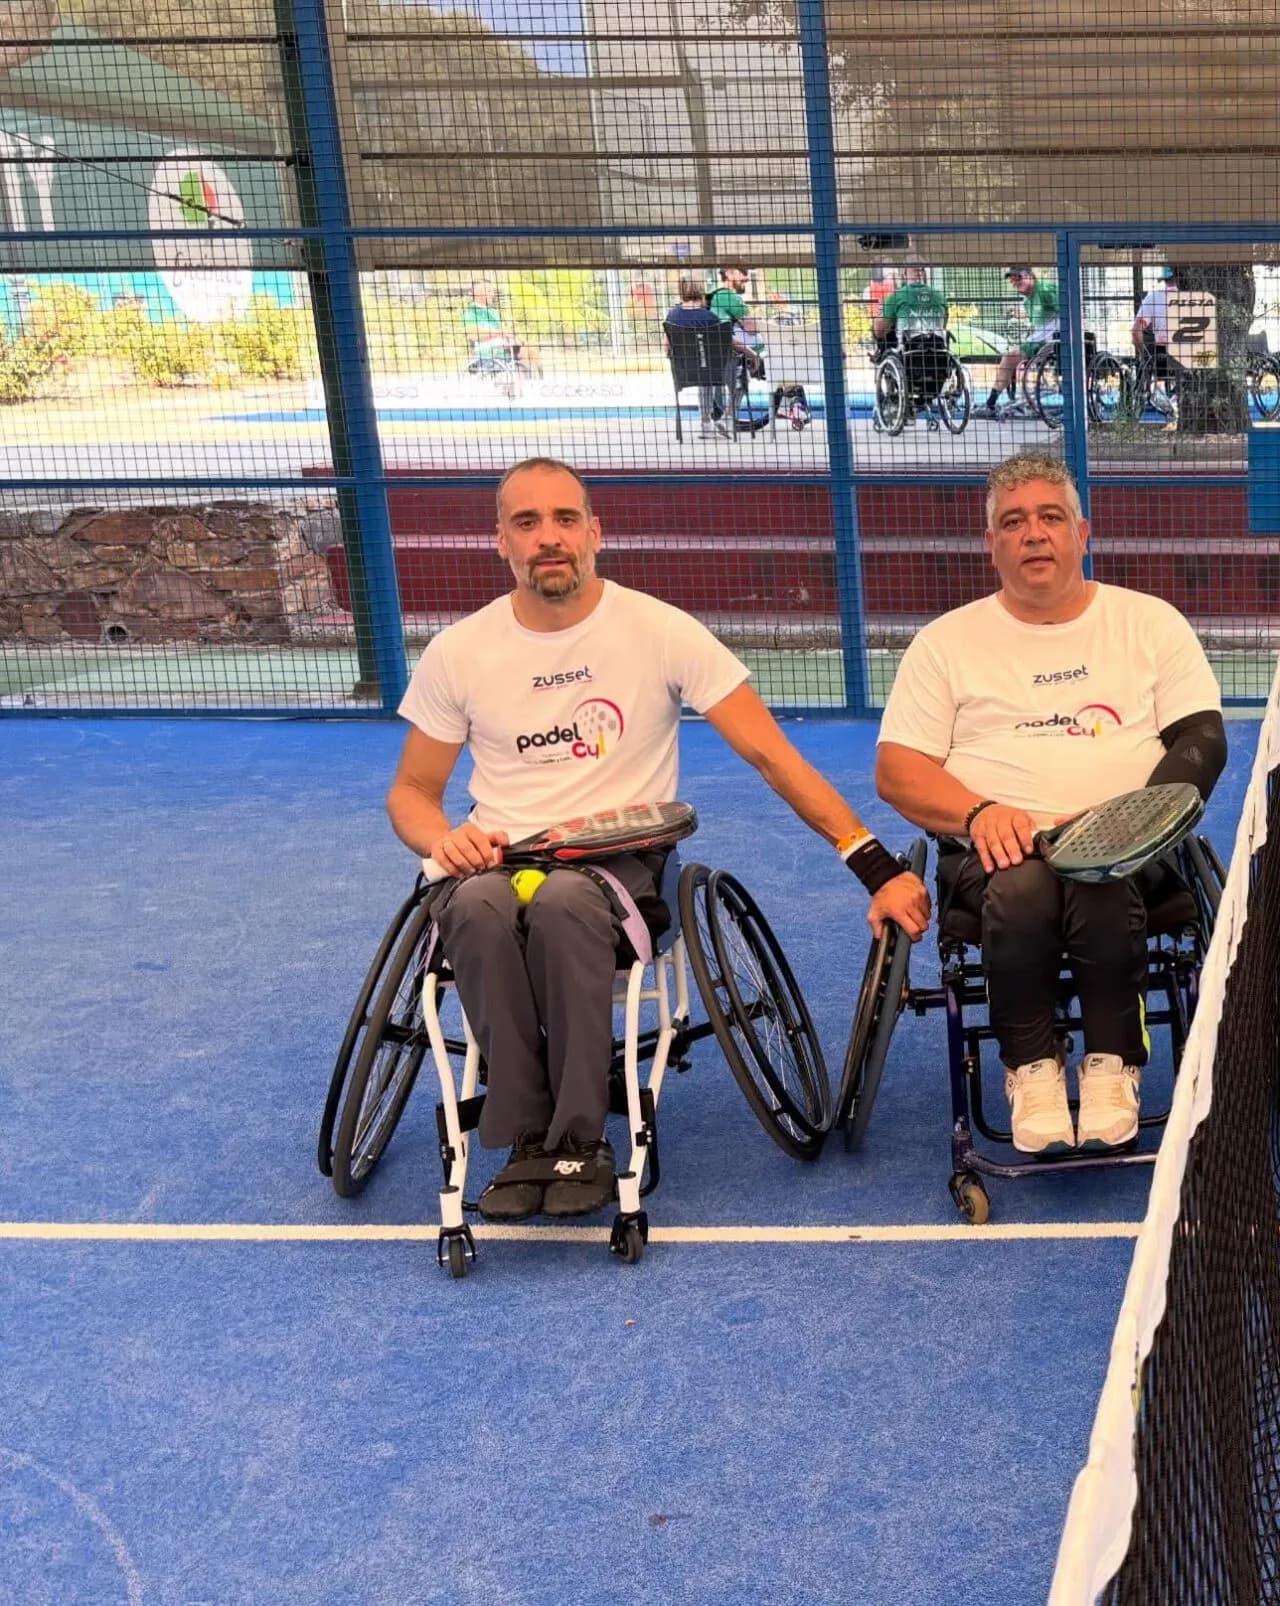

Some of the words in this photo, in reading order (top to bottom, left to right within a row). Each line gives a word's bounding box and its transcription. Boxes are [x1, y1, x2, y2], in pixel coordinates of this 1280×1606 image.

[1172, 317, 1211, 342] 2
[532, 665, 592, 688] zusset
[1033, 664, 1088, 684] zusset
[516, 721, 583, 754] padel
[553, 1160, 586, 1176] RGK
